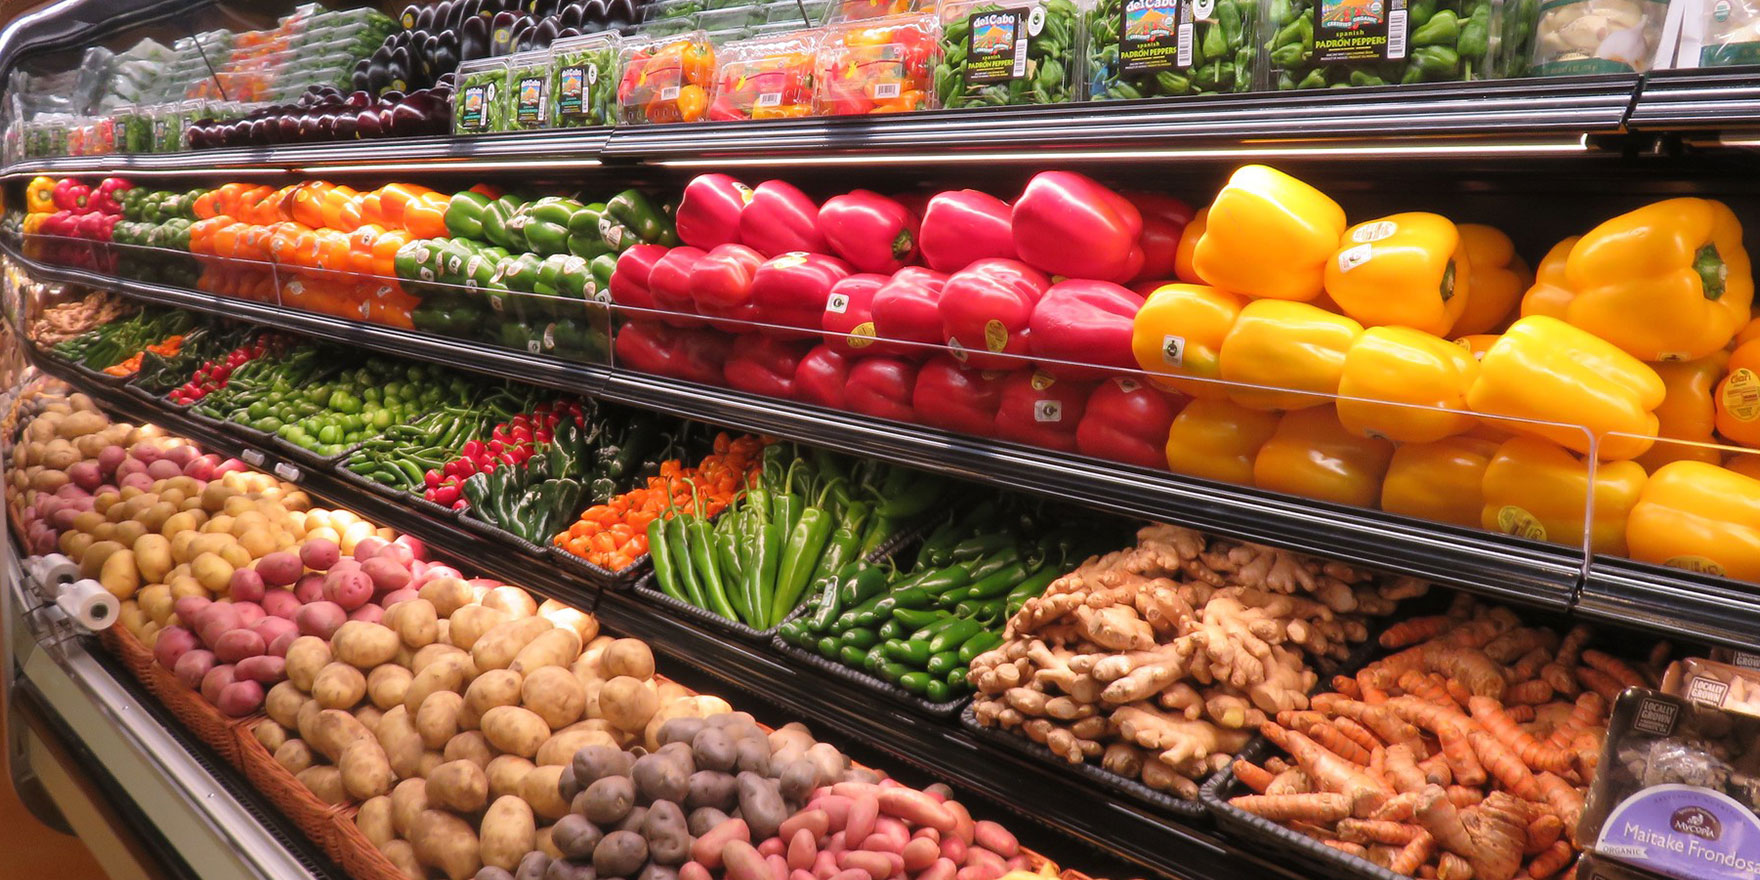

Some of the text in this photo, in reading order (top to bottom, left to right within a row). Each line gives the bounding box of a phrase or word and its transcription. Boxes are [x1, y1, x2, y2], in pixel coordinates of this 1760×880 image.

[973, 14, 1015, 27] delCabo
[1336, 30, 1365, 38] spanish
[1315, 38, 1351, 49] PADRÓN
[1352, 36, 1387, 46] PEPPERS
[1121, 48, 1149, 59] PADRÓN
[1150, 47, 1177, 56] PEPPERS
[993, 59, 1014, 67] PEPPERS
[1736, 656, 1760, 667] GROW
[1694, 679, 1725, 694] LOCALLY
[1691, 688, 1721, 702] GROWN
[1644, 701, 1676, 715] LOCALLY
[1641, 709, 1672, 725] GROWN
[1602, 845, 1641, 856] ORGANIC
[1623, 821, 1760, 875] Maitake Frondosa
